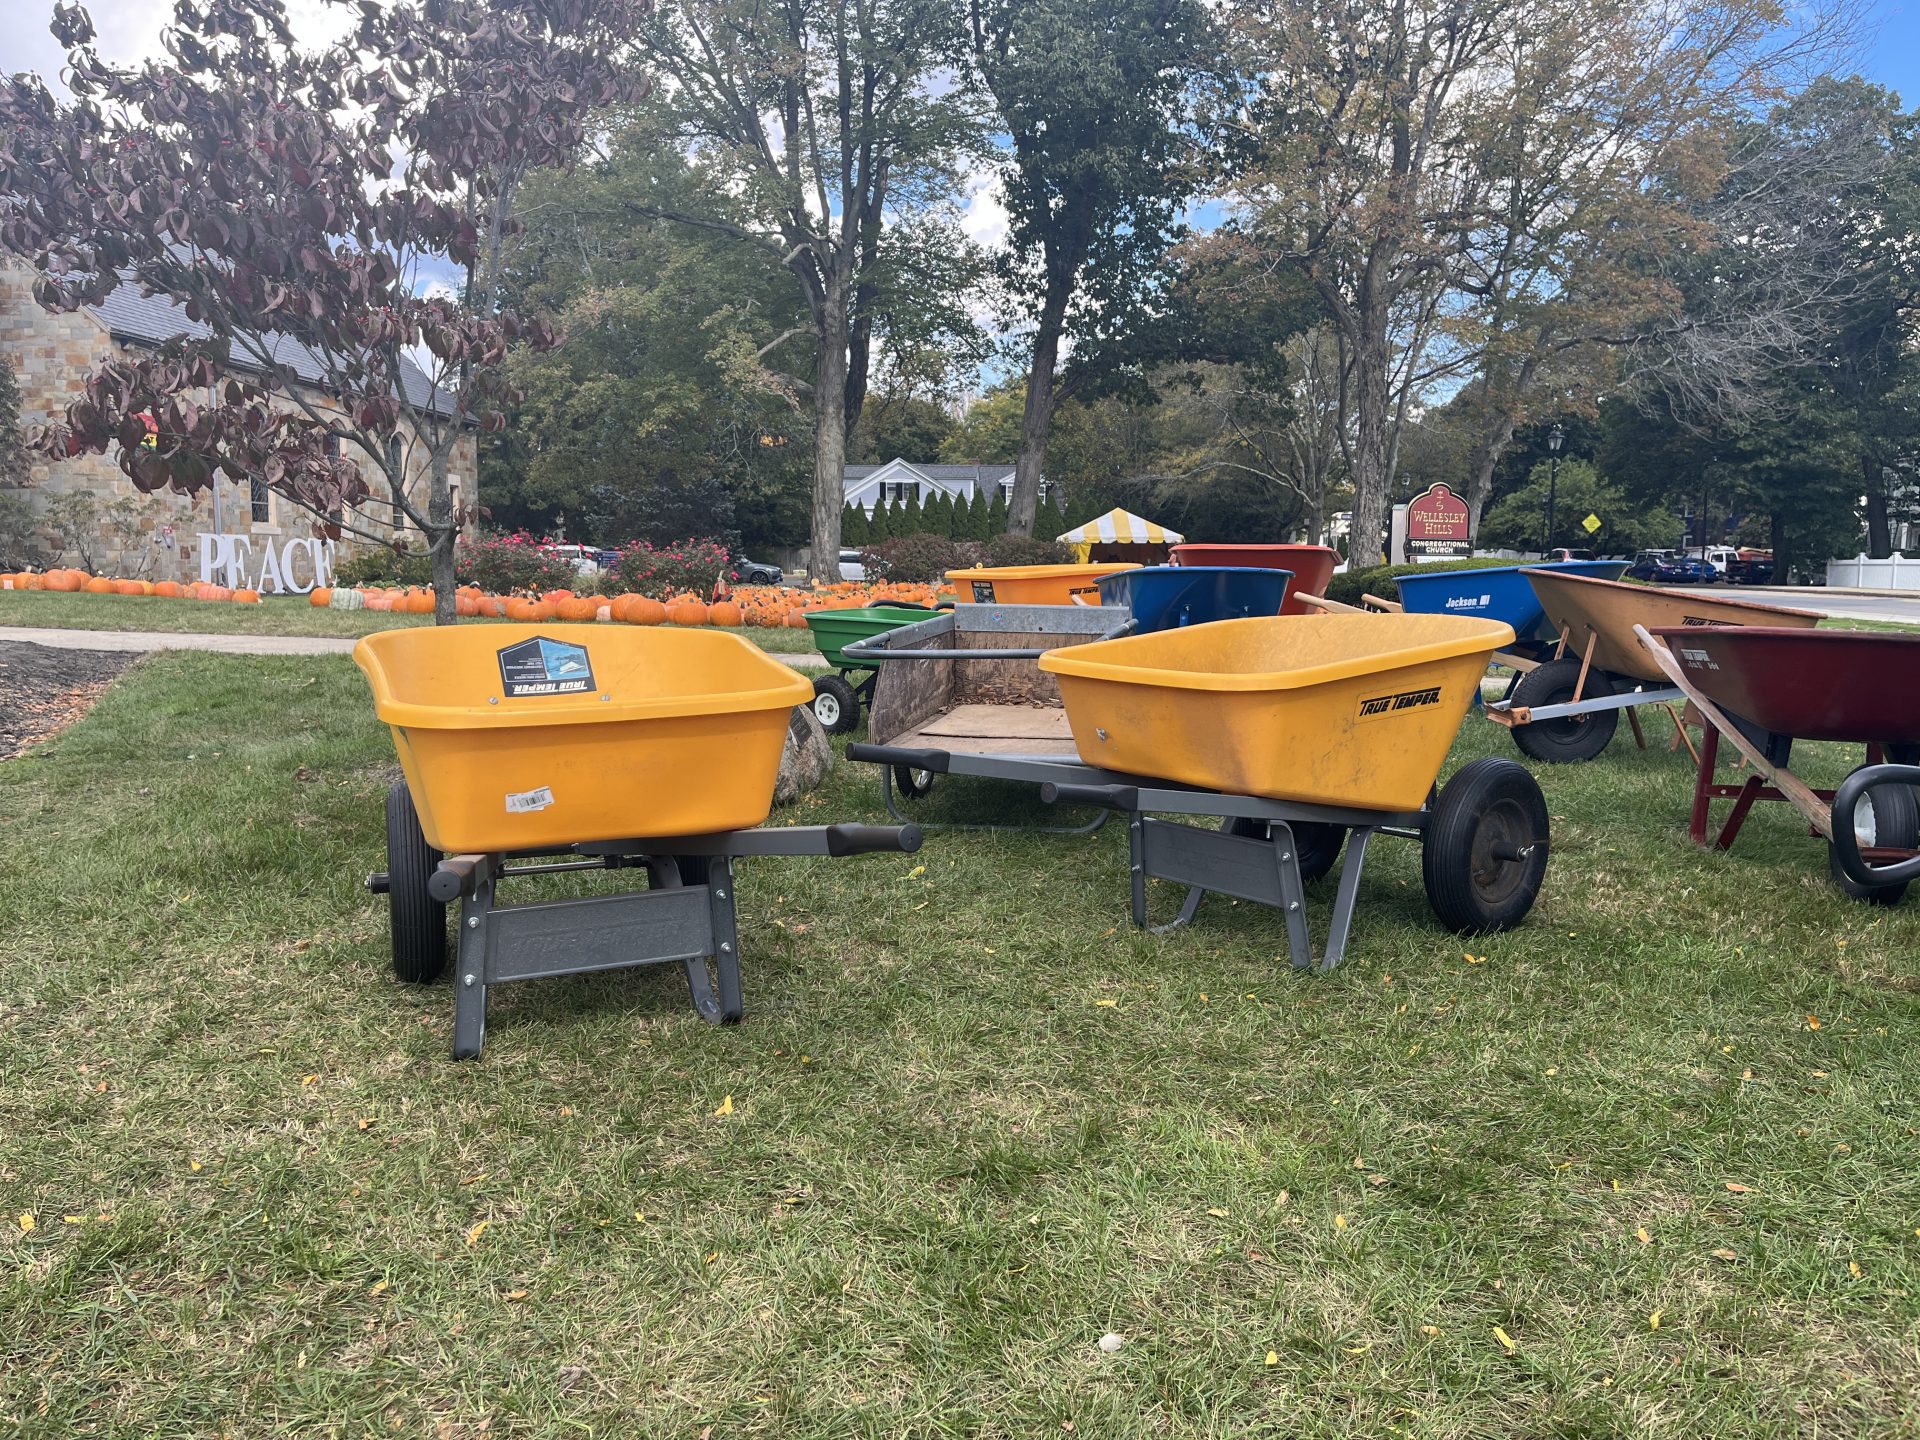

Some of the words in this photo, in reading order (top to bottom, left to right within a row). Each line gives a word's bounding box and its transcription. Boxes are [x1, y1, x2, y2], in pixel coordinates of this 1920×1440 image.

[1413, 511, 1466, 523] WELLESLEY
[1424, 523, 1453, 534] HILLS
[196, 532, 336, 594] PEACE
[1445, 597, 1478, 608] Jackson
[512, 683, 559, 694] TEMPER
[558, 680, 588, 690] TRUE
[1359, 695, 1393, 716] TRUE
[1391, 686, 1442, 710] TEMPER
